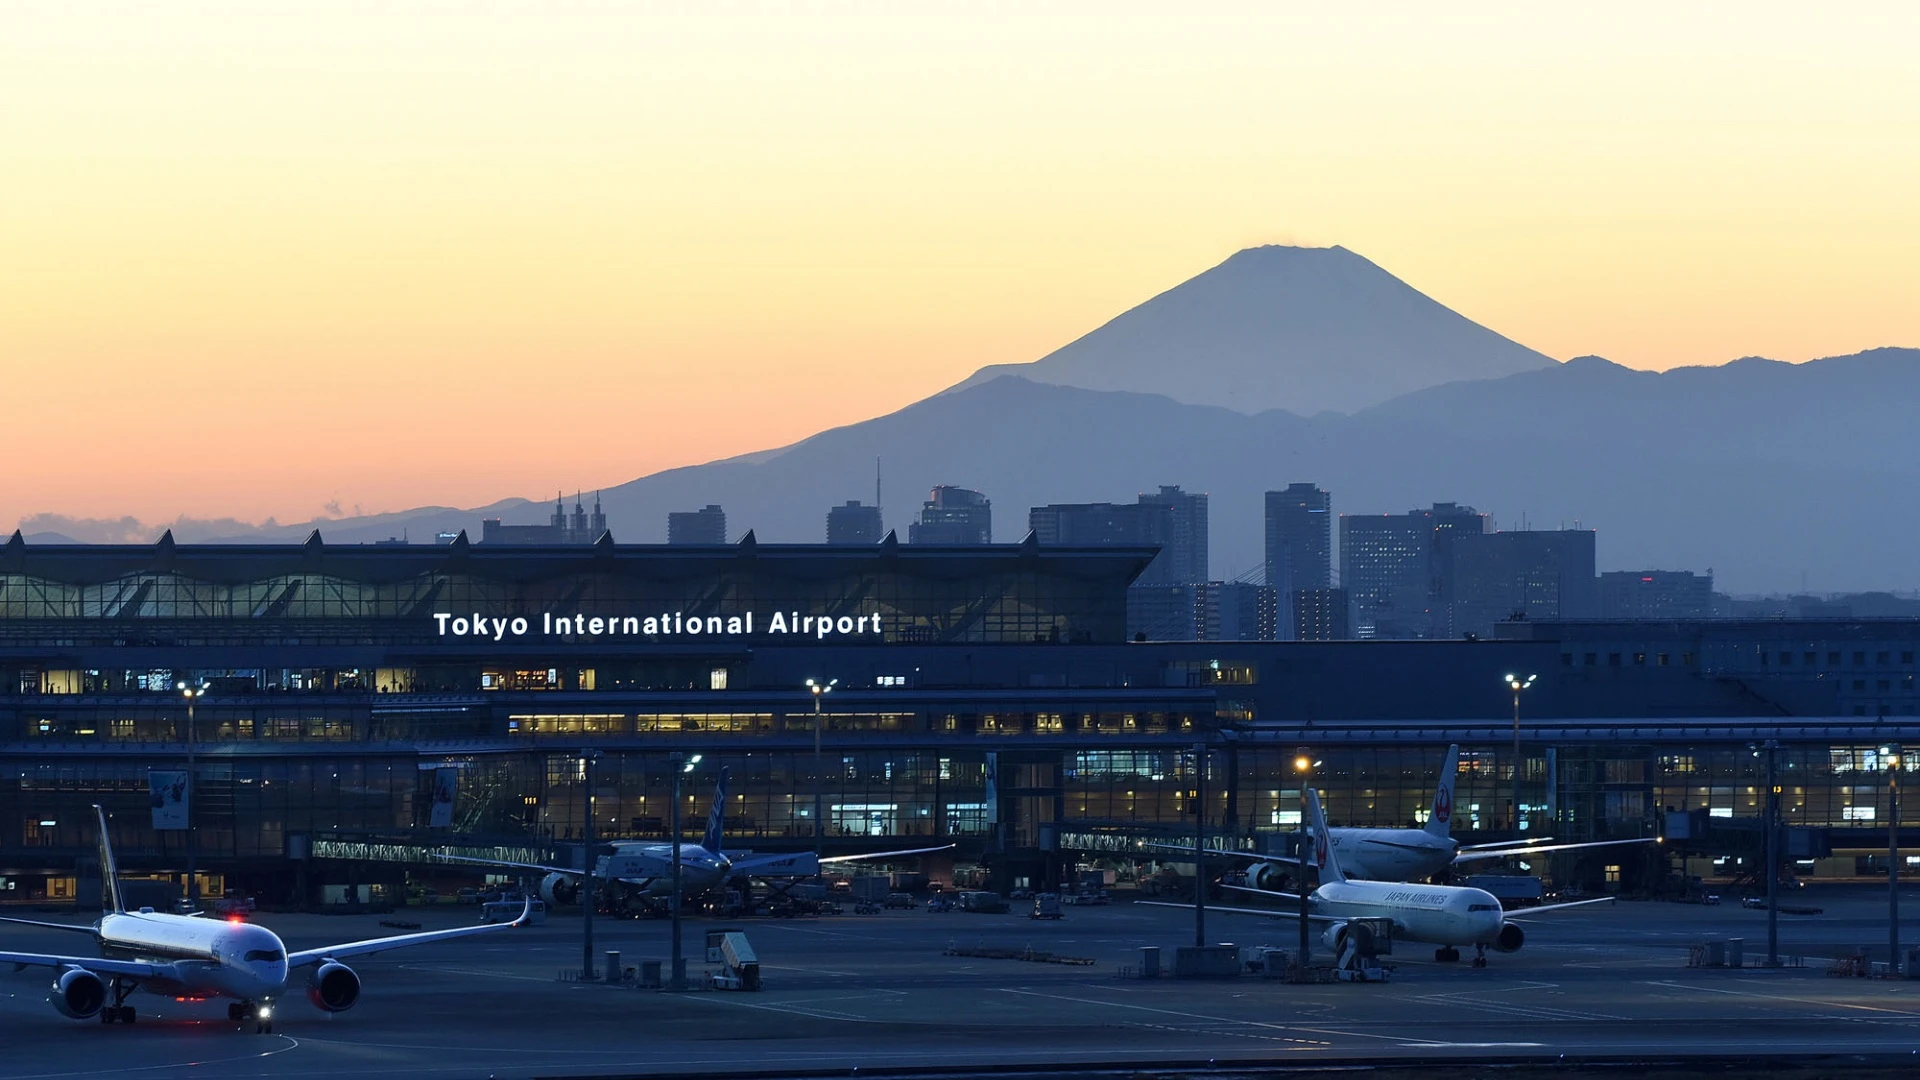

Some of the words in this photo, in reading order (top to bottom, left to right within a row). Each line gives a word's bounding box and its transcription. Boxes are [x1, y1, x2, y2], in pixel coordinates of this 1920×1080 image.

[433, 612, 529, 641] Tokyo
[544, 611, 753, 635] International
[768, 611, 882, 639] Airport
[524, 797, 537, 805] 111
[1385, 891, 1411, 902] JAPAN
[1410, 893, 1447, 905] AIRLINES
